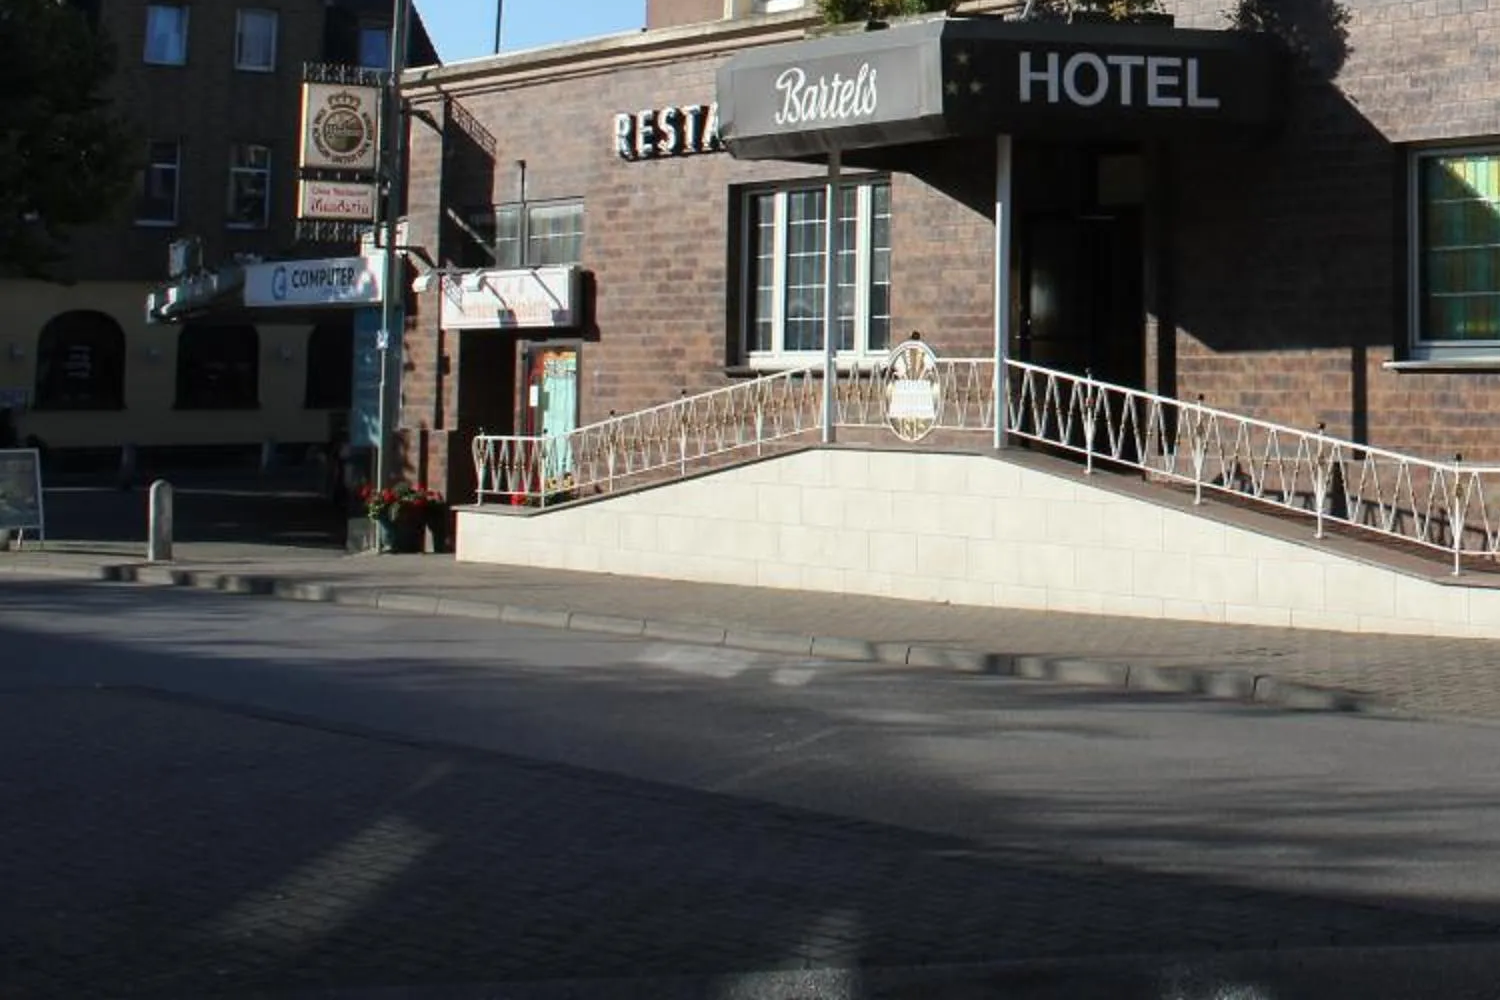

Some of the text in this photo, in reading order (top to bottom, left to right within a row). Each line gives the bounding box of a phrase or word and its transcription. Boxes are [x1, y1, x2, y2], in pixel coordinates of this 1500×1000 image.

[775, 62, 877, 125] Bartels
[1019, 51, 1220, 108] HOTEL
[291, 267, 355, 289] COMPUTER
